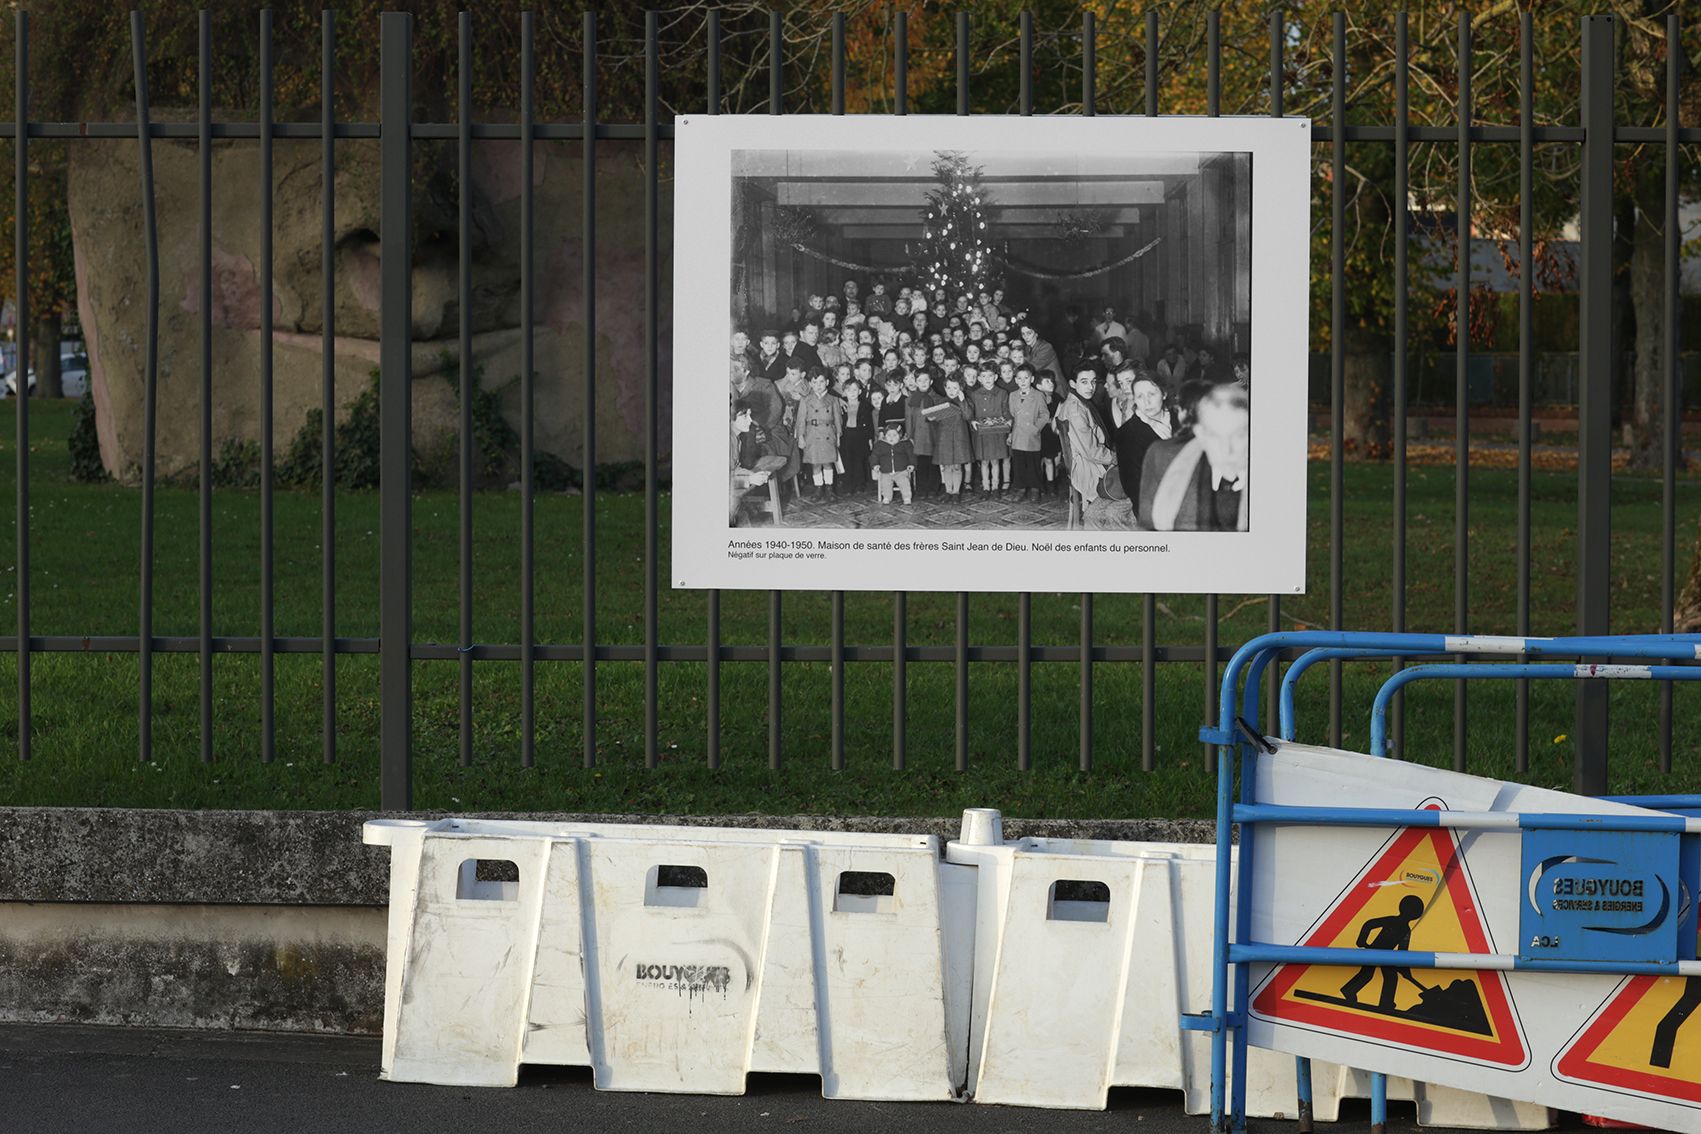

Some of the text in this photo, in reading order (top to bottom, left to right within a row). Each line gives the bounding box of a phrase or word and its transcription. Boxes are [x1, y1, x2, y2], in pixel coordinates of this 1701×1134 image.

[727, 540, 1171, 554] Années 1940-1950. Maison de santé des frères Saint Jean de Dieu. Noël des enfants du personnel.
[727, 551, 753, 560] Négatif
[768, 552, 793, 560] plaque
[636, 963, 730, 982] BOUYG
